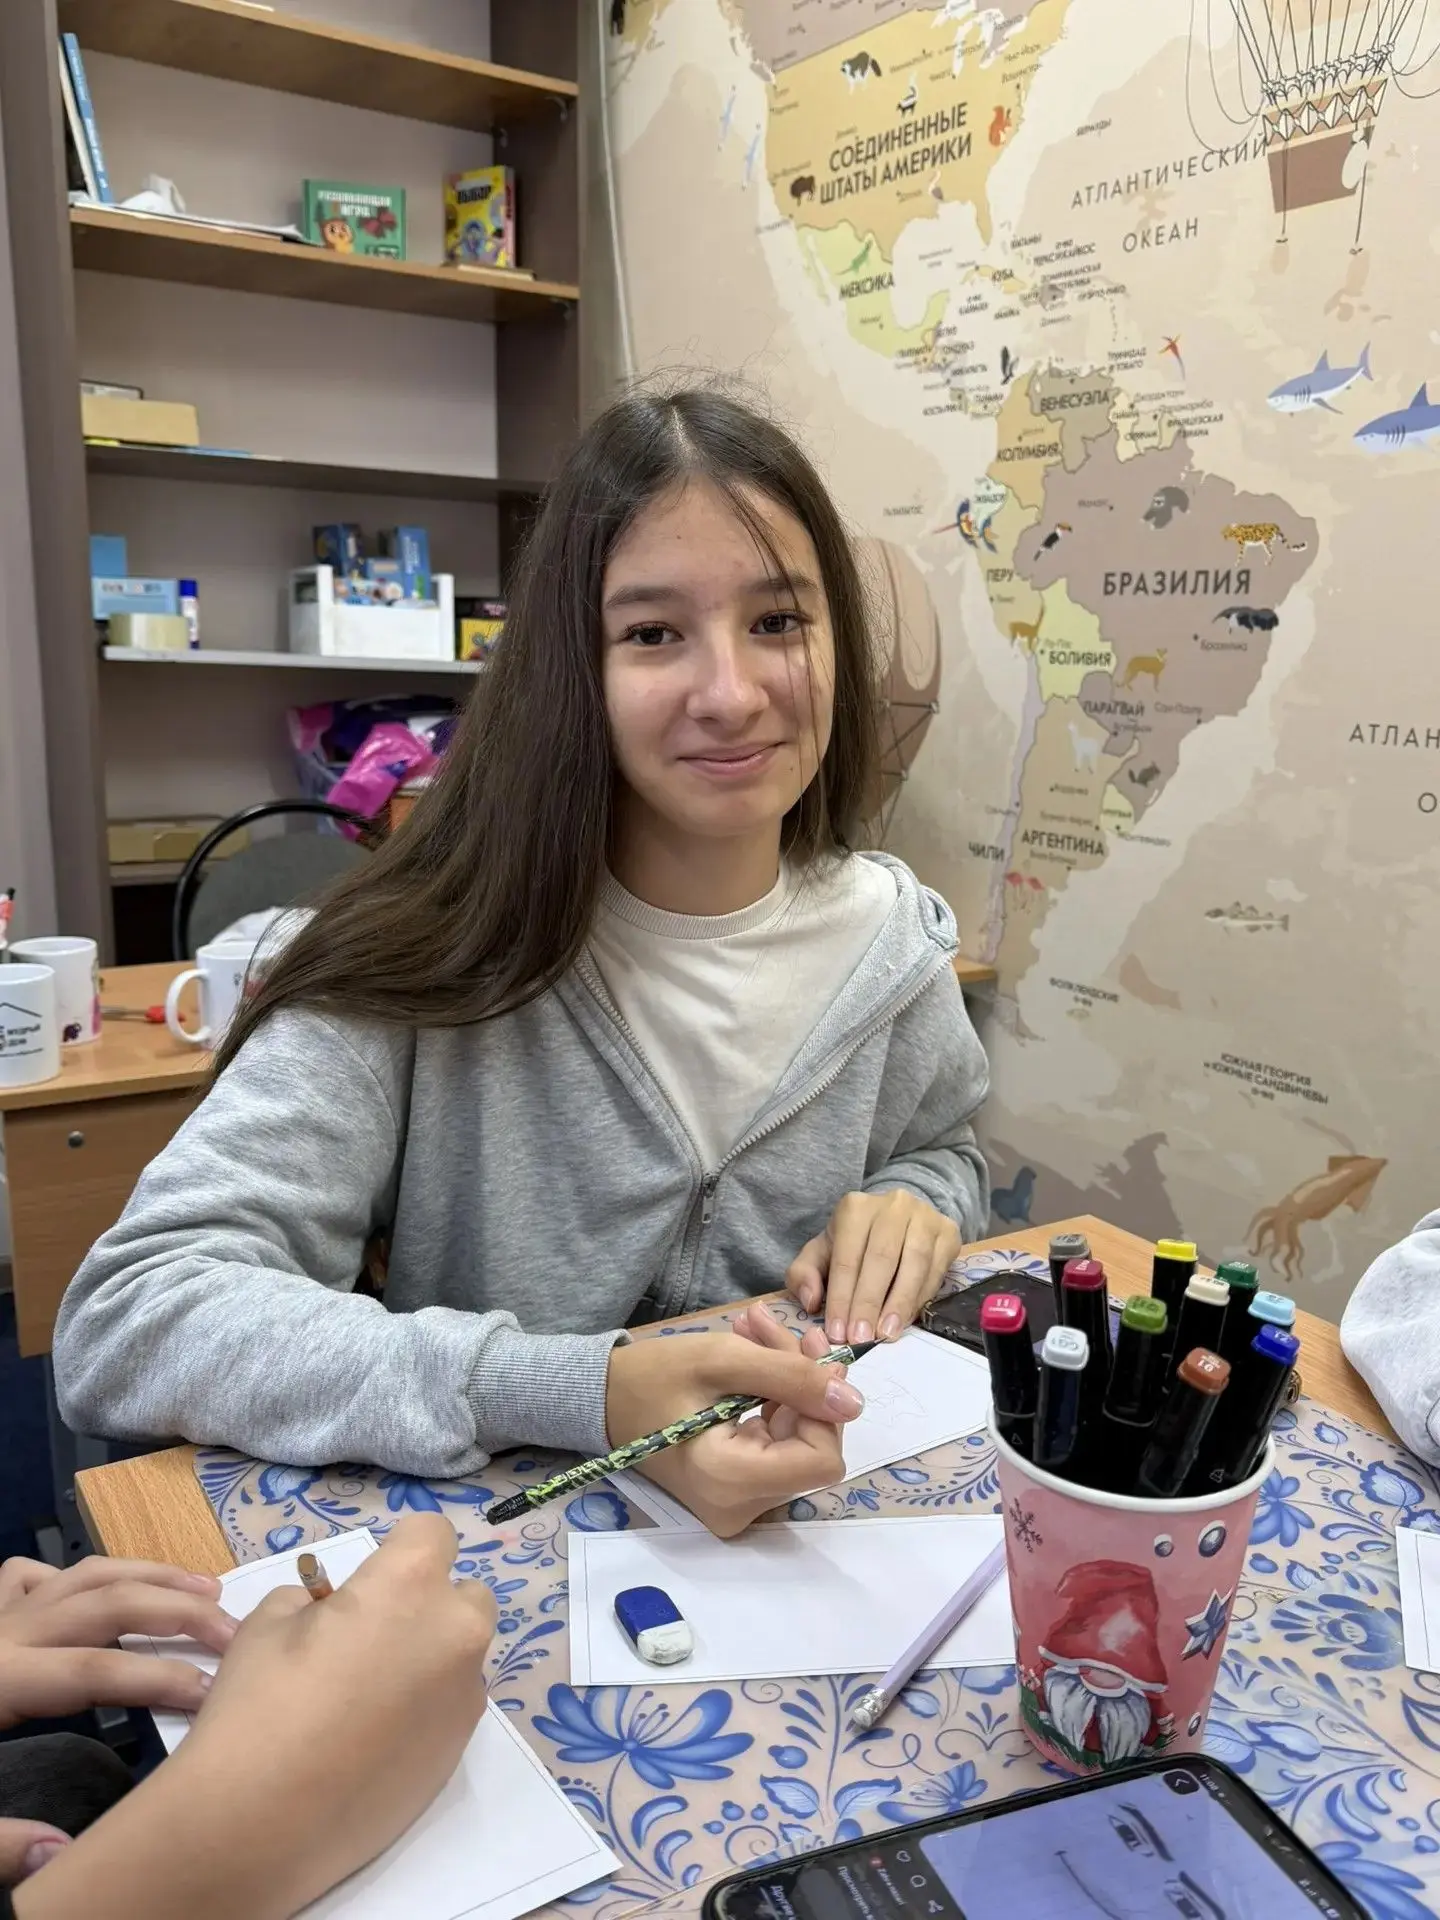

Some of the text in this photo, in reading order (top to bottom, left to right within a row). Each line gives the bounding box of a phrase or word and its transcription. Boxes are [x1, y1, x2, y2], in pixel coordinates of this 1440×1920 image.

[829, 102, 968, 172] СОЕДИНЕННЫЕ
[820, 165, 878, 205] ШТАТЫ
[880, 132, 973, 185] АМЕРИКИ
[1071, 132, 1267, 209] АТЛАНТИЧЕСКИЙ
[1122, 217, 1199, 253] ОКЕАН
[839, 272, 896, 301] МЕКСИКА
[1040, 390, 1111, 413] ВЕНЕСУЭЛА
[997, 442, 1059, 462] КОЛУМБИЯ
[986, 568, 1014, 583] ПЕРУ
[1103, 569, 1251, 596] БРАЗИЛИЯ
[1049, 651, 1112, 666] БОЛИВИЯ
[1083, 699, 1146, 717] ПАРАГВАЙ
[968, 841, 1005, 862] ЧИЛИ
[1021, 828, 1105, 856] АРГЕНТИНА
[1212, 1061, 1253, 1084] ЮЖНЫЕ
[1254, 1073, 1329, 1105] САНДВИЧЕВЫ
[1221, 1052, 1311, 1087] ЮЖНАЯ ГЕОРГИЯ
